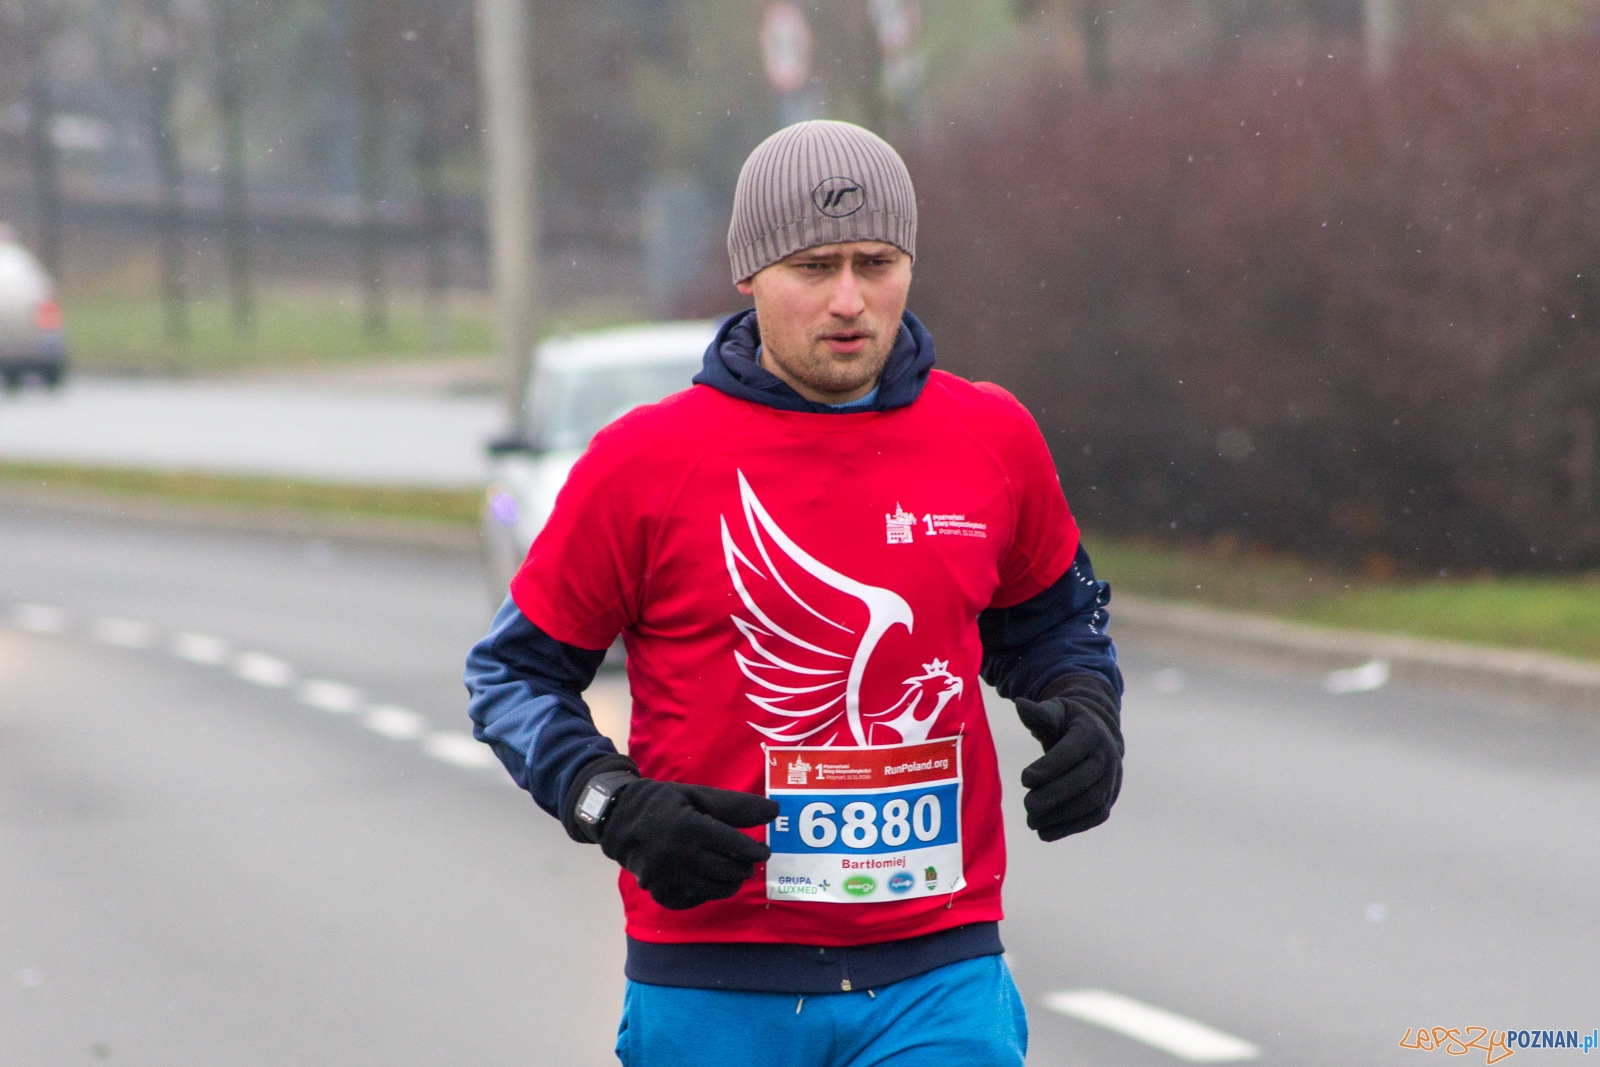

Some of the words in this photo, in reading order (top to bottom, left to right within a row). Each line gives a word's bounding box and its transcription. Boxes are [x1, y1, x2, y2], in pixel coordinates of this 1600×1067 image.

[922, 513, 937, 535] 1
[815, 763, 825, 780] 1
[884, 759, 949, 776] RunPoland.org
[775, 816, 790, 832] E
[798, 794, 942, 849] 6880
[841, 856, 907, 869] Bartłomiej
[778, 876, 812, 885] GRUPA
[778, 886, 818, 895] LUXMED
